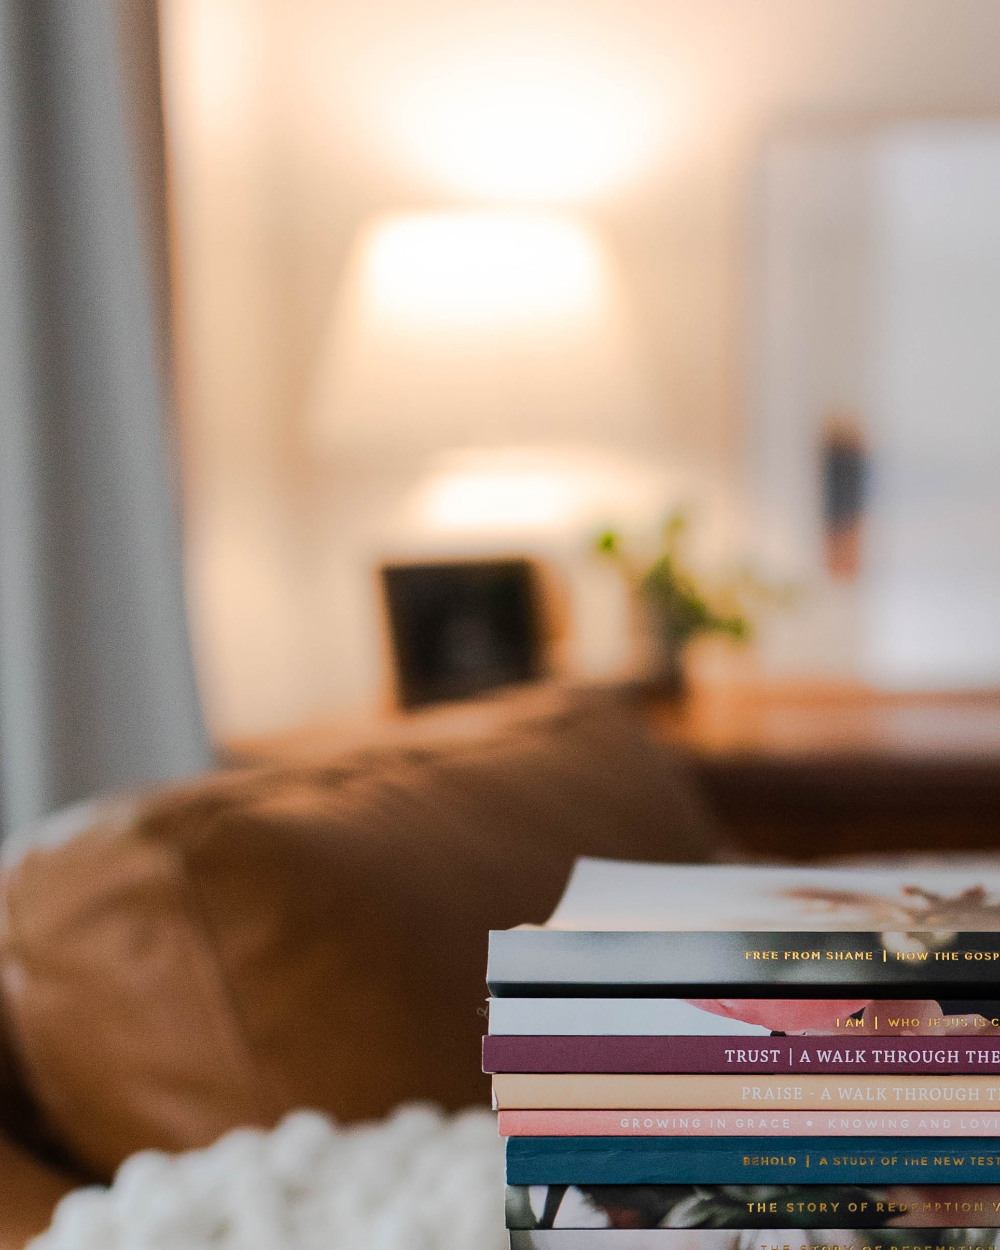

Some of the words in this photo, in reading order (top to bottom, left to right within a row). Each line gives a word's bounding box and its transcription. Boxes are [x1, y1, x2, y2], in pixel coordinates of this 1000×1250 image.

[745, 951, 779, 961] FREE
[783, 951, 821, 961] FROM
[826, 951, 873, 961] SHAME
[896, 951, 928, 961] HOW
[934, 951, 959, 961] THE
[725, 1049, 780, 1063] TRUST
[799, 1050, 812, 1063] A
[816, 1050, 866, 1063] WALK
[872, 1050, 960, 1063] THROUGH
[965, 1050, 1000, 1063] THE
[741, 1087, 803, 1100] PRAISE
[820, 1087, 832, 1100] A
[836, 1087, 887, 1100] WALK
[892, 1088, 980, 1100] THROUGH
[620, 1119, 701, 1129] GROWING
[709, 1119, 726, 1129] IN
[735, 1119, 791, 1129] GRACE
[828, 1119, 910, 1129] KNOWING
[918, 1119, 952, 1129] AND
[743, 1156, 796, 1166] BEHOLD
[819, 1156, 828, 1166] A
[832, 1156, 875, 1166] STUDY
[880, 1156, 898, 1166] OF
[903, 1156, 928, 1166] THE
[933, 1156, 965, 1166] NEW
[747, 1202, 777, 1213] THE
[786, 1202, 839, 1213] STORY
[848, 1202, 868, 1213] OF
[876, 1202, 983, 1213] REDEMPTION
